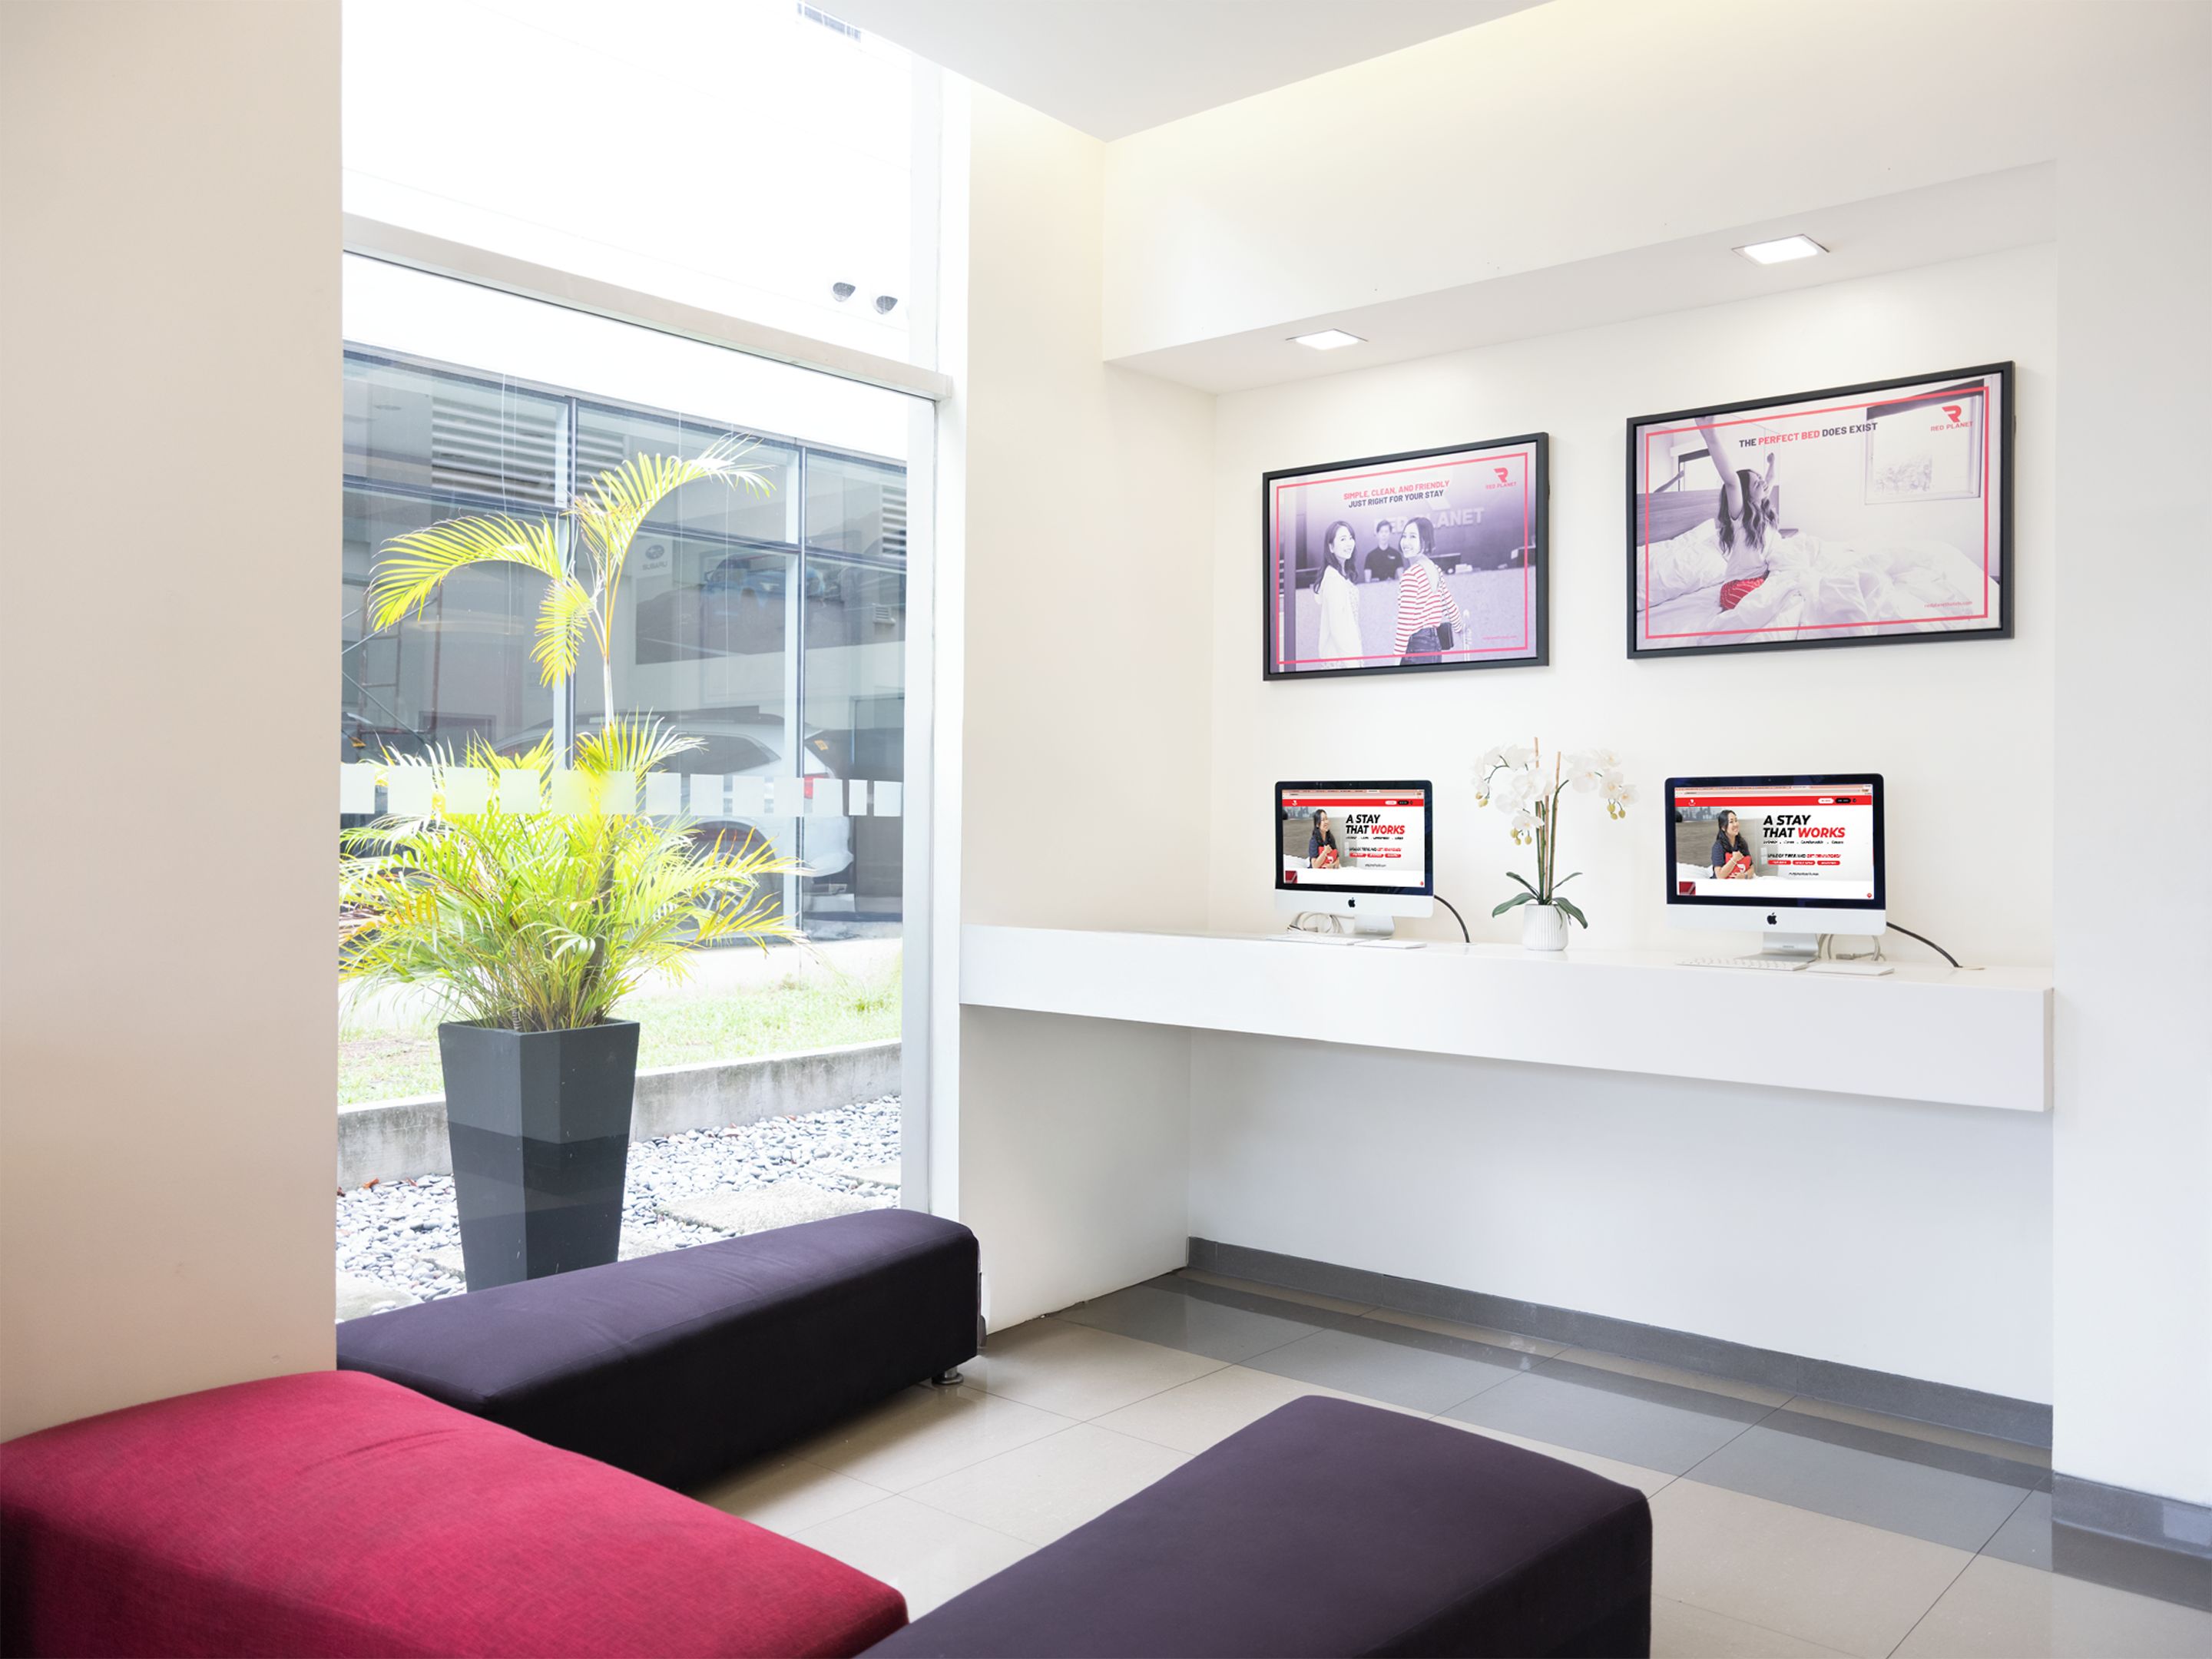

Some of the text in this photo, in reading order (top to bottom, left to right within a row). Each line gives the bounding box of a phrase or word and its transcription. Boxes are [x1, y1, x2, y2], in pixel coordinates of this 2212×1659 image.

[1946, 421, 1973, 429] PLANET
[1739, 422, 1879, 448] THE PERFECT BED DOES EXIST
[1343, 480, 1450, 501] SIMPLE, CLEAN, AND FRIENDLY
[1349, 489, 1444, 508] JUST RIGHT FOR YOUR STAY
[1346, 814, 1380, 823] A STAY
[1763, 815, 1811, 825] A STAY
[1346, 825, 1405, 834] THAT WORKS
[1763, 827, 1845, 838] THAT WORKS
